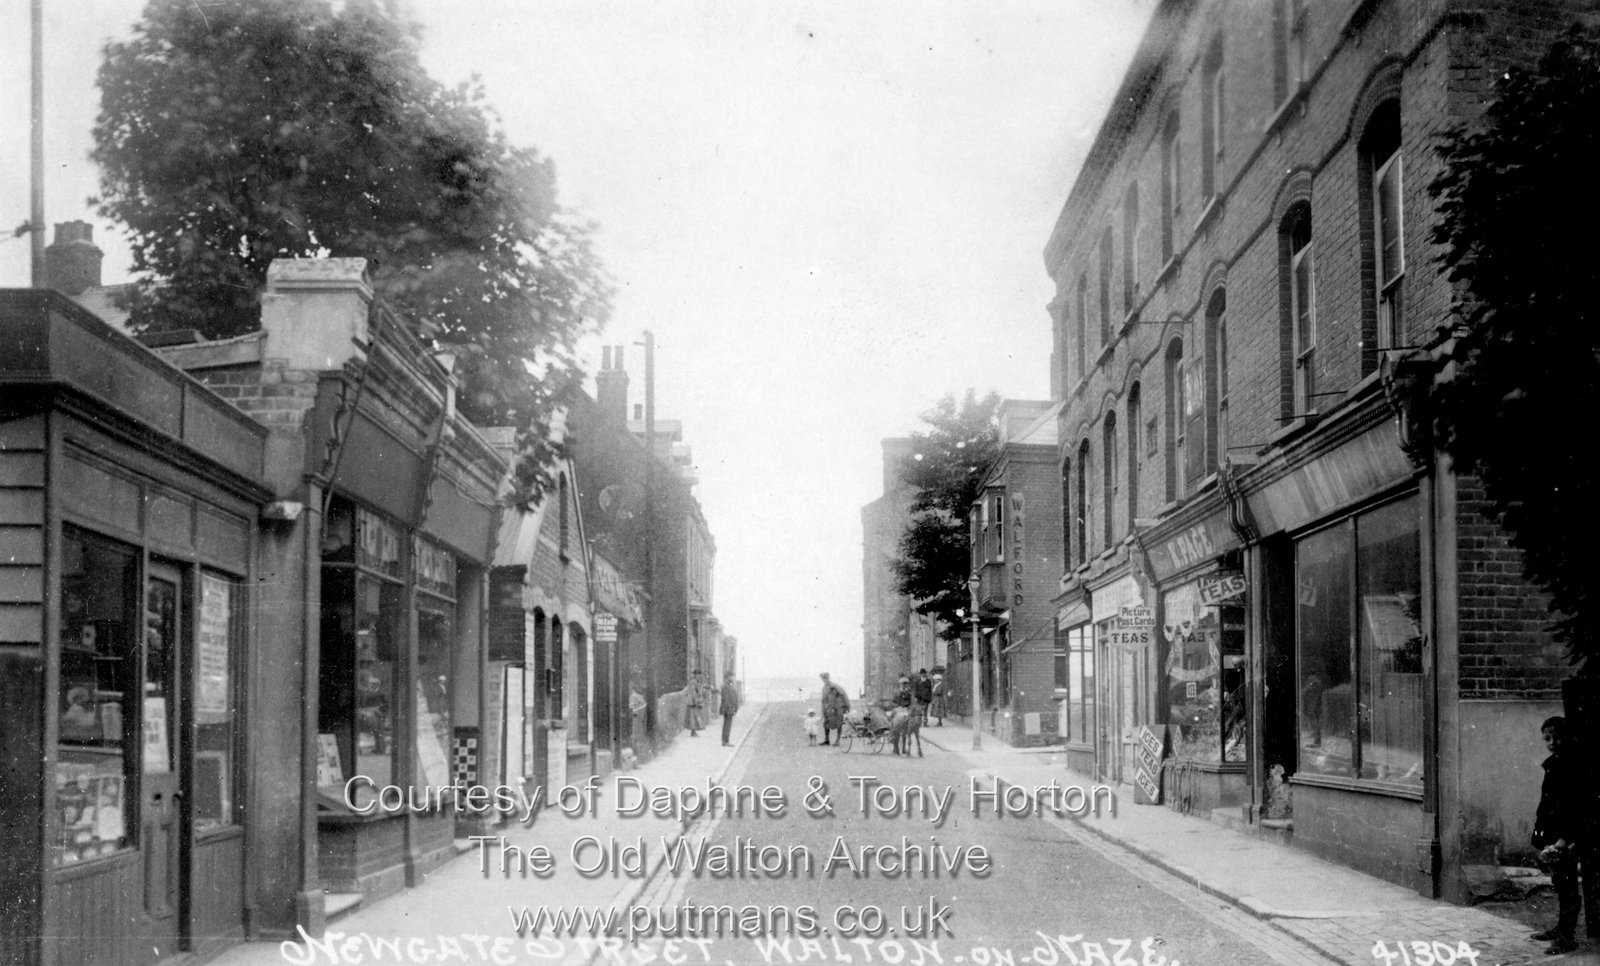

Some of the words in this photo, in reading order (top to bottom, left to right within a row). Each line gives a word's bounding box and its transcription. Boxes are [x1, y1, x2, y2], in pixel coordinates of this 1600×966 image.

[1012, 498, 1023, 606] WALFORD
[1199, 576, 1245, 603] TEAS
[1121, 607, 1152, 617] Picture
[1111, 632, 1149, 644] TEAS
[1142, 730, 1161, 754] ICES
[1140, 747, 1159, 776] TEAS
